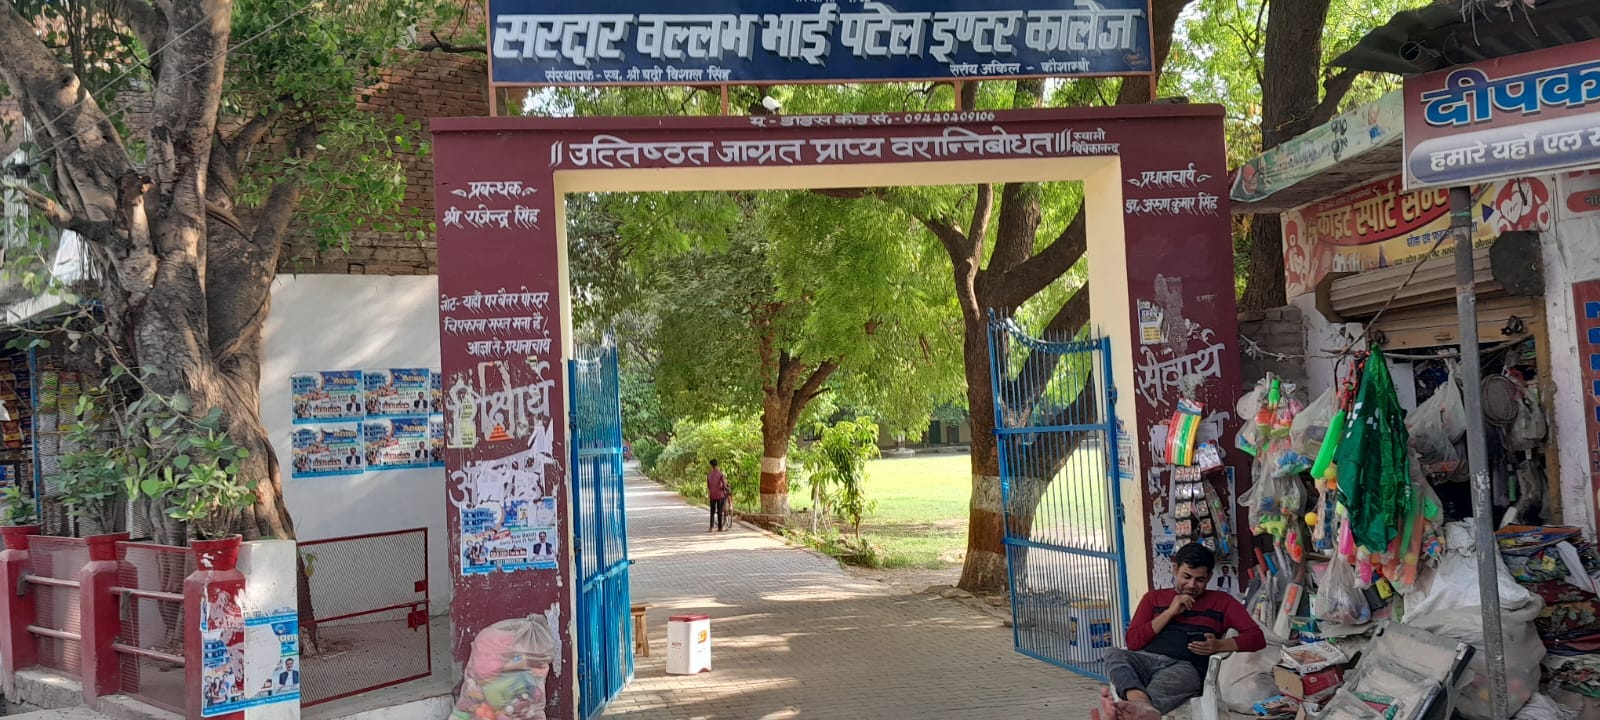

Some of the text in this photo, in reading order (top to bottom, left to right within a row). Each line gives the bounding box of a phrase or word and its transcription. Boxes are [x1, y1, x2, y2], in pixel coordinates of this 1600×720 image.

[494, 1, 1144, 67] सरदार वल्लभ भाई पटेल इण्टर कालेज
[627, 65, 641, 81] श्री
[667, 65, 703, 81] विशाल
[707, 65, 731, 81] सिंह
[980, 60, 1020, 75] अकिल
[1040, 57, 1090, 73] कौशाम्बी
[1072, 128, 1106, 142] स्वामी
[569, 134, 714, 167] उत्तिष्ठत
[716, 140, 805, 165] जाग्रत
[809, 137, 885, 163] प्राप्य
[1429, 140, 1487, 171] हमारे
[1542, 129, 1584, 155] एल
[1140, 162, 1198, 189] प्रधानाचार्य
[467, 181, 523, 201] प्रबन्धक
[443, 204, 540, 230] श्री राजेन्द्र सिंह
[1171, 197, 1198, 216] कुमार
[1198, 192, 1219, 217] सिंह
[1353, 180, 1397, 236] स्पोर्ट
[484, 294, 500, 312] पर
[520, 286, 550, 312] पोस्टर
[443, 316, 487, 336] चिपकाना
[512, 317, 532, 335] मना
[465, 340, 492, 359] आज्ञा
